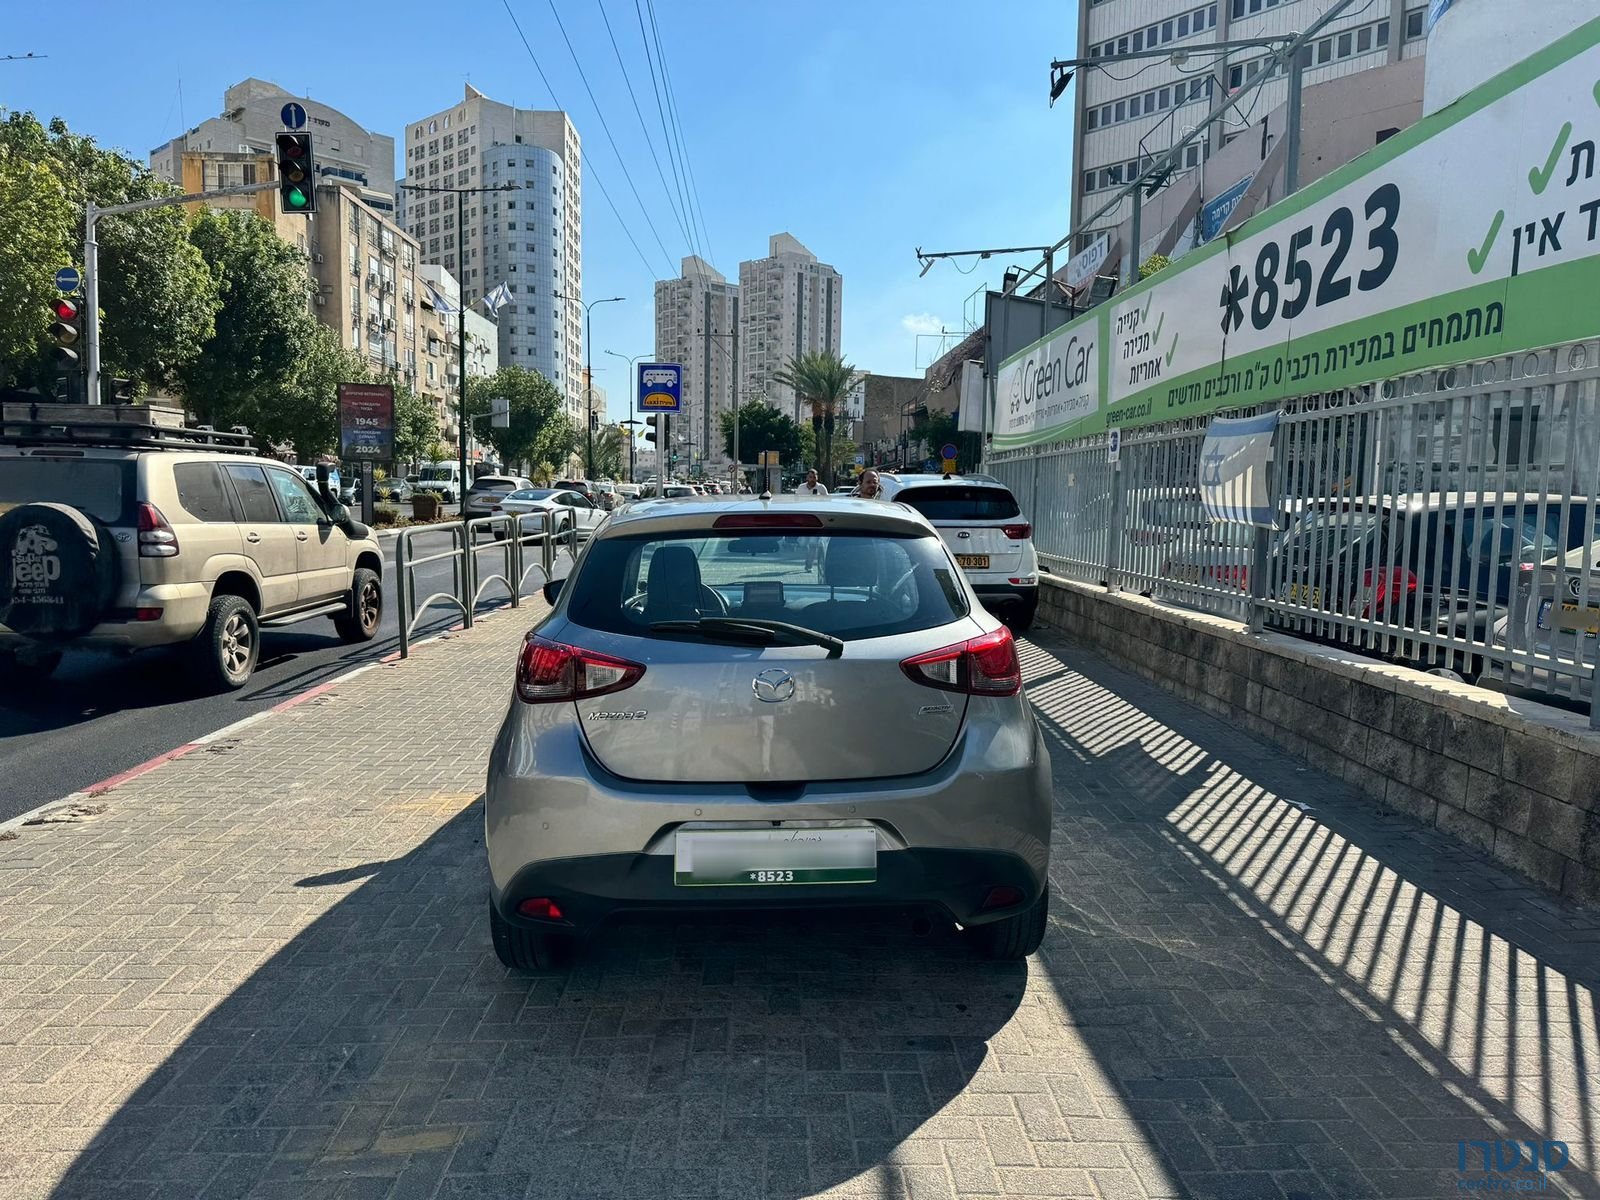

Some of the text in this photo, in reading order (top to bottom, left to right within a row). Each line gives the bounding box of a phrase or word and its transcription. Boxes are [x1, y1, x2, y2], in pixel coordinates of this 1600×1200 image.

[1211, 201, 1231, 222] קדימה
[1081, 241, 1104, 270] דפוס
[1511, 211, 1566, 277] אין
[1116, 308, 1140, 335] קנייה
[1402, 301, 1504, 355] מתמחים
[1123, 332, 1150, 360] מכירה
[1323, 332, 1395, 374] במכירת
[1024, 335, 1094, 405] Green Car
[1129, 356, 1162, 386] אחריות
[1273, 357, 1283, 385] 0
[1287, 352, 1320, 381] רכבי
[1167, 383, 1201, 408] חדשים
[1204, 371, 1241, 400] ורכבים
[355, 417, 379, 426] 1945
[1106, 397, 1153, 428] green-car.co.il
[355, 445, 381, 454] 2024
[11, 549, 61, 589] jeep
